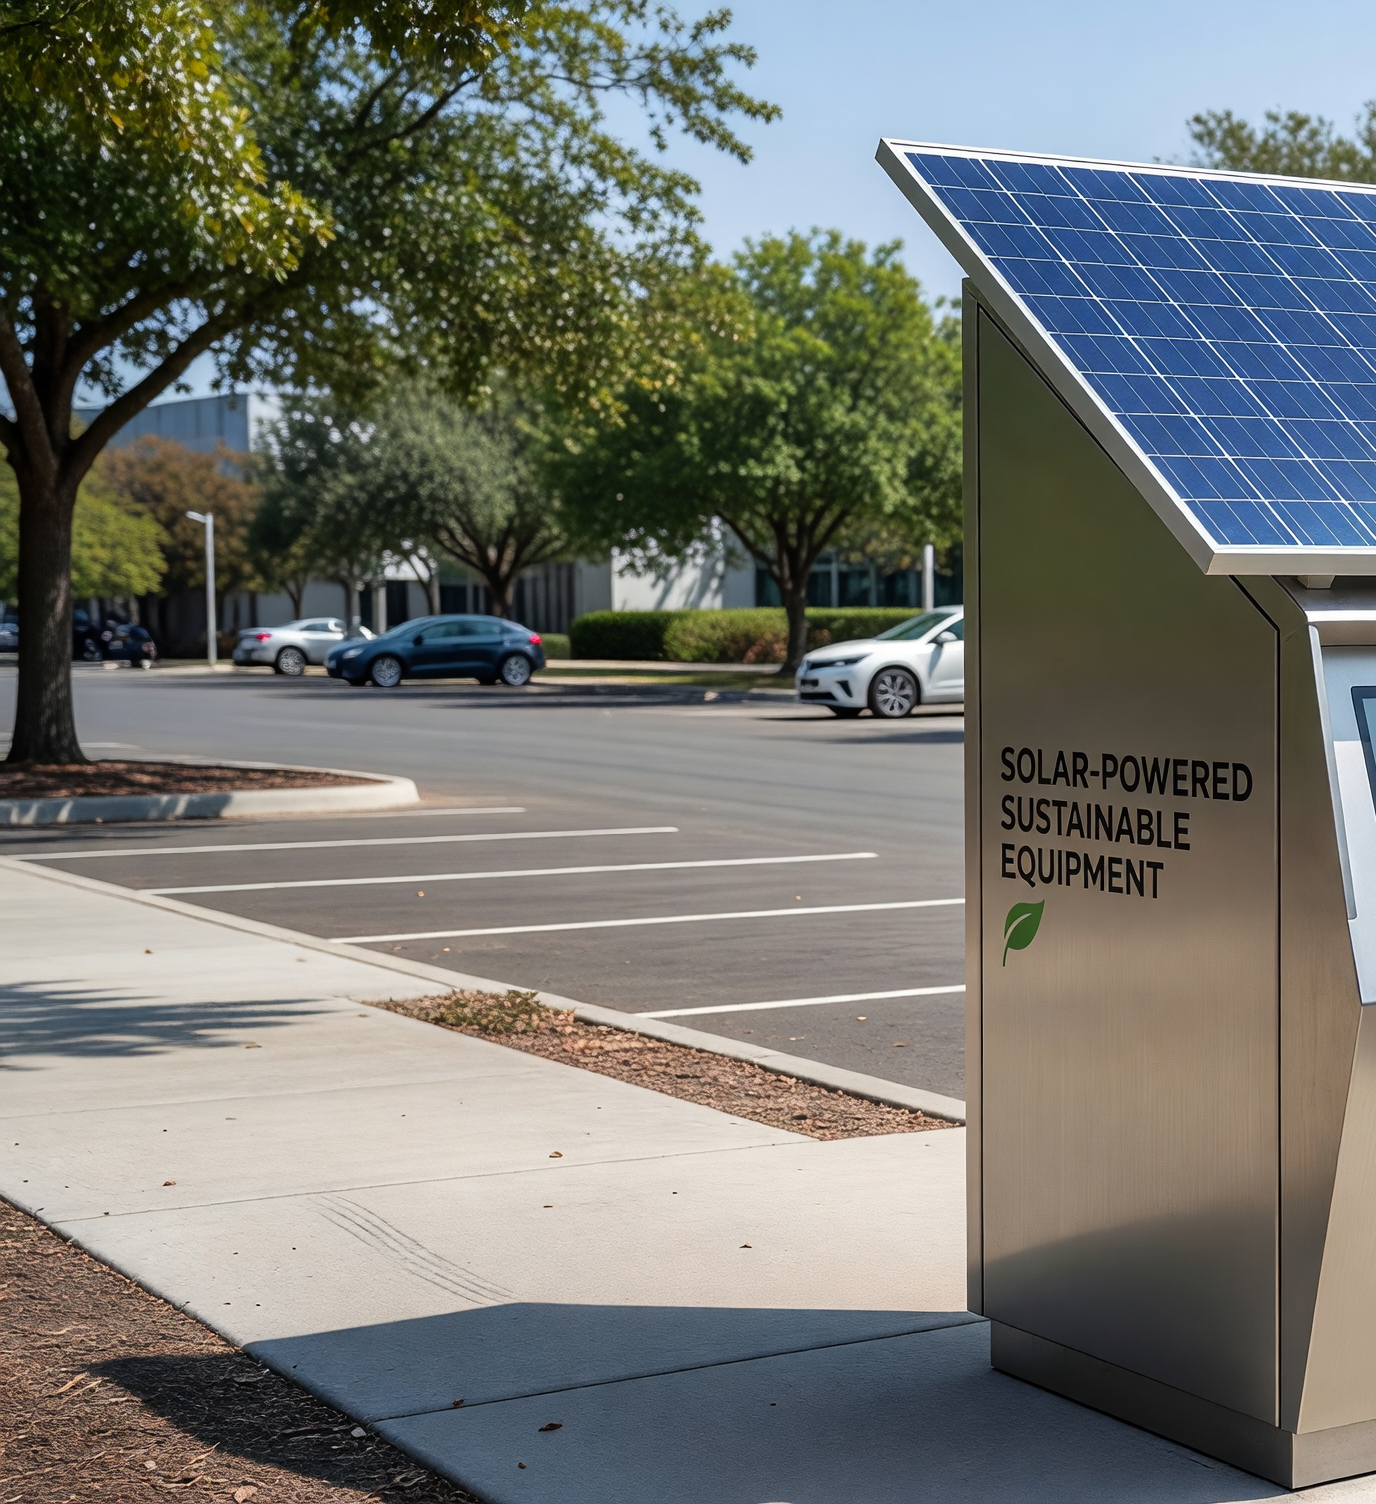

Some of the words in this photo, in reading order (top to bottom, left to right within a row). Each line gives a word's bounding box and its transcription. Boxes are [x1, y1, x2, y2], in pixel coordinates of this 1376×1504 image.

[1000, 746, 1253, 802] SOLAR-POWERED
[1000, 794, 1191, 851] SUSTAINABLE
[1001, 842, 1164, 899] EQUIPMENT
